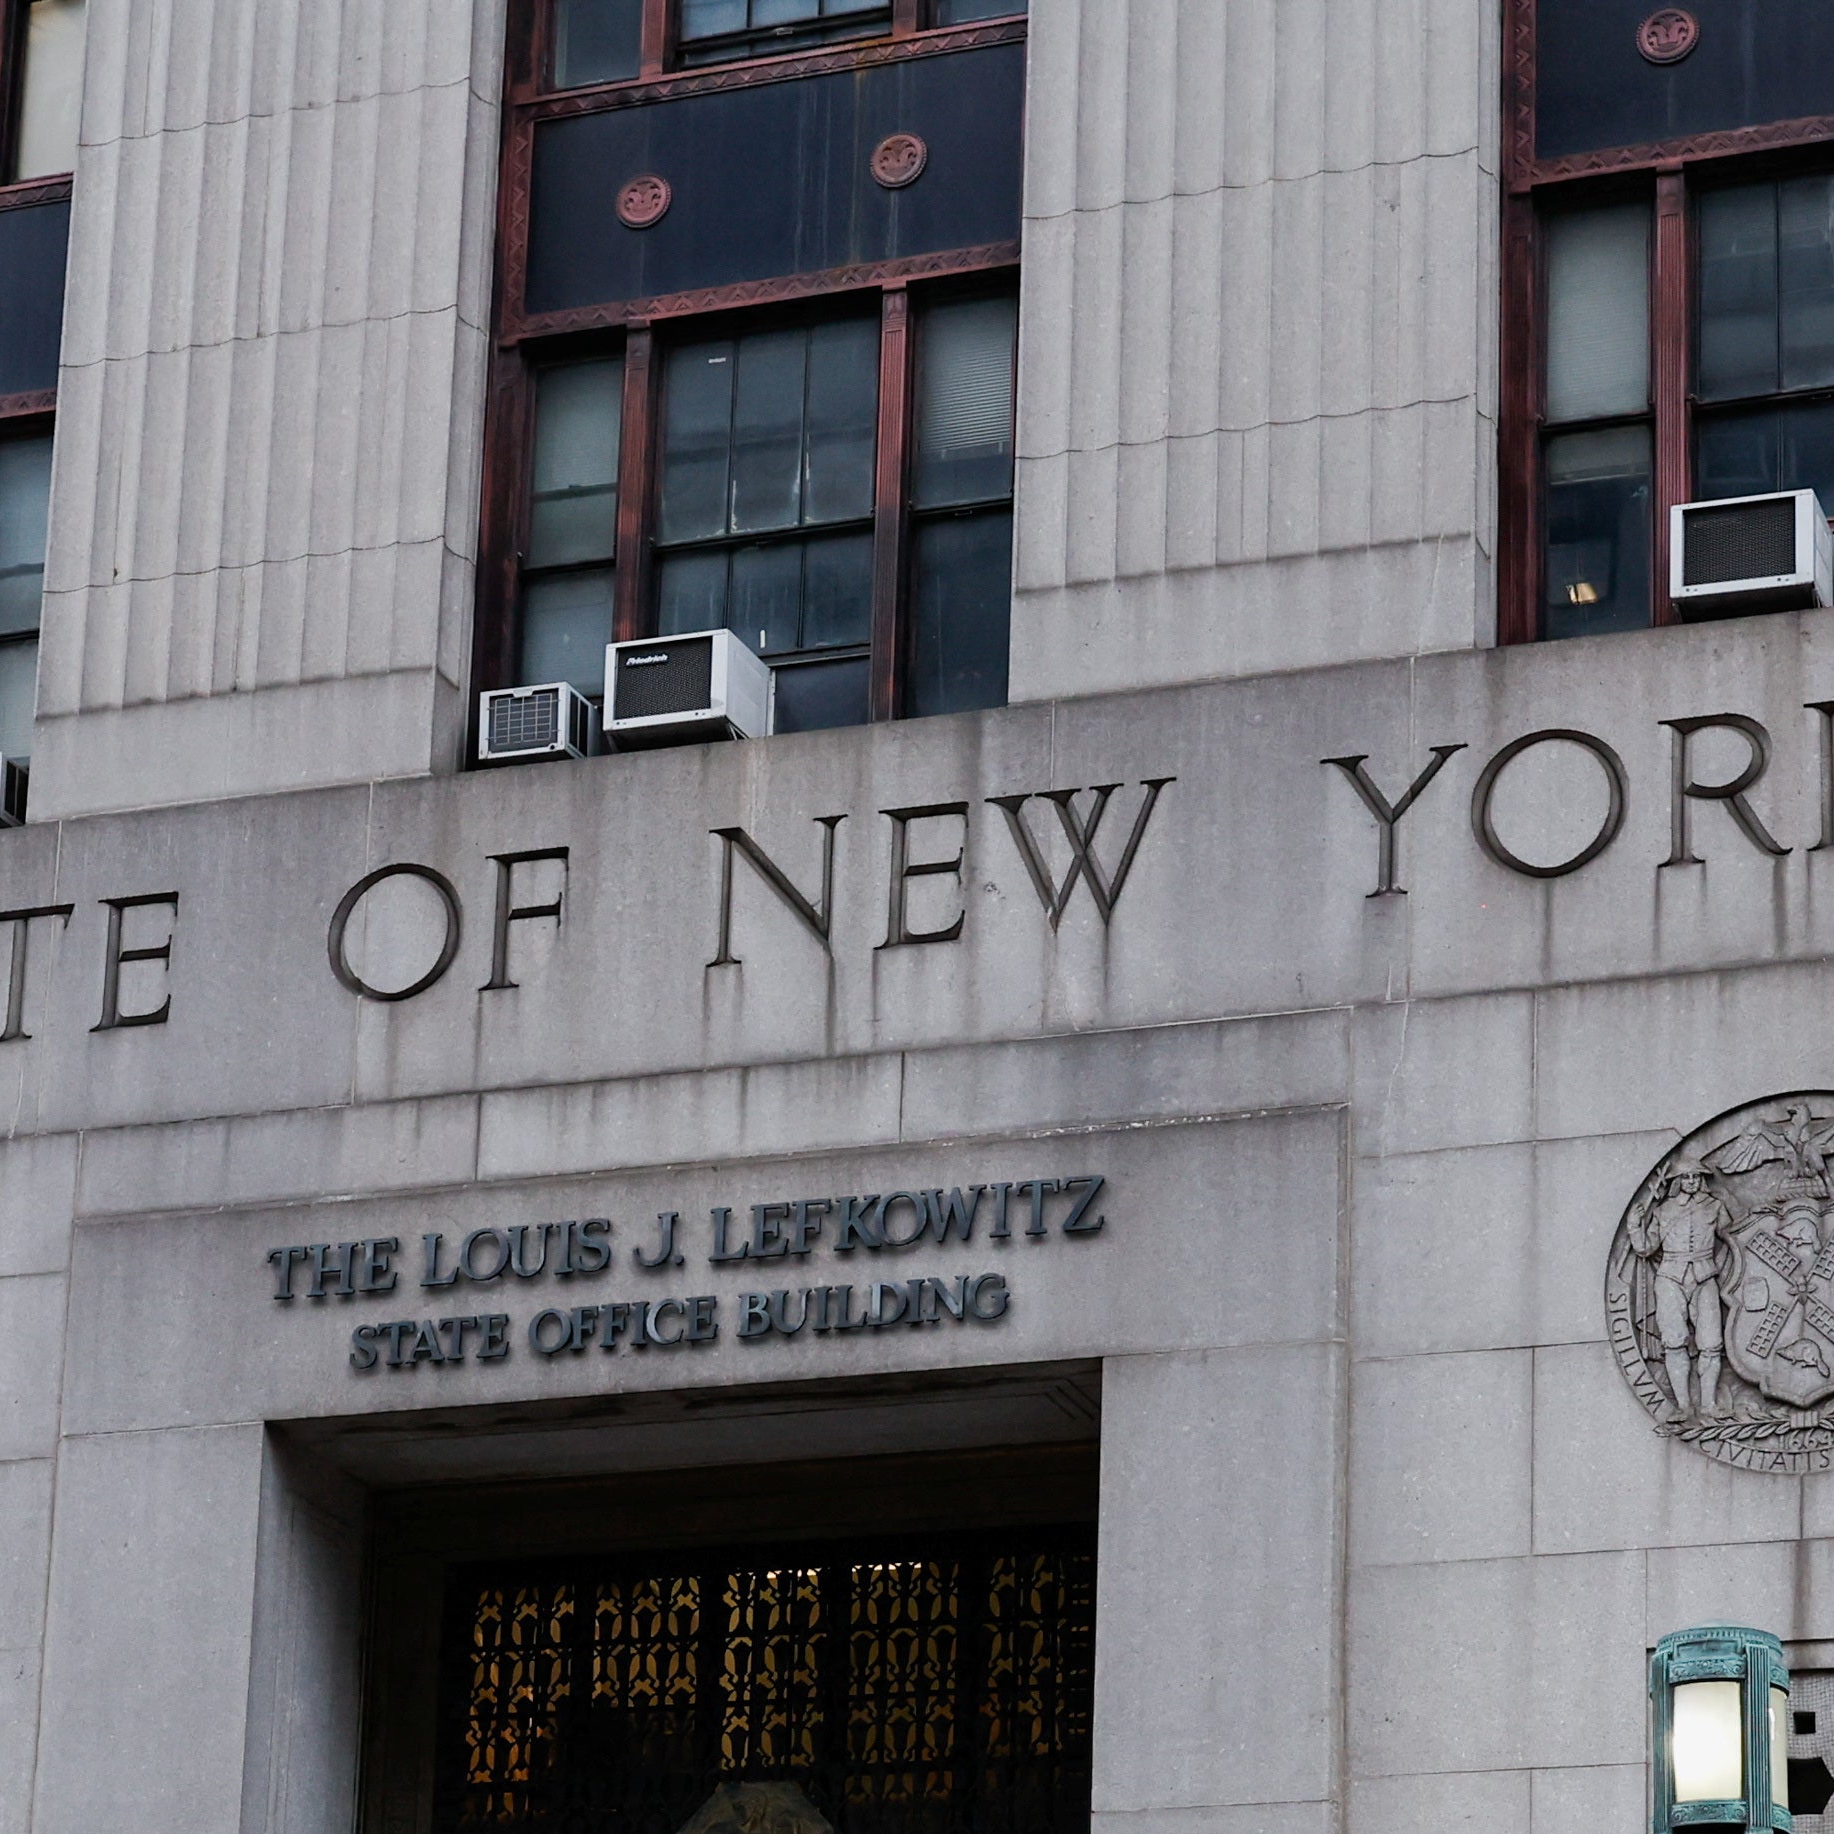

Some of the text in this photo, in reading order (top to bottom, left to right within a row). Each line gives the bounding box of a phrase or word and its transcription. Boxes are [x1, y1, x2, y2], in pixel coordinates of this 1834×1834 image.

[327, 846, 570, 1001] OF
[705, 776, 1177, 968] NEW
[266, 1173, 1106, 1300] THE LOUIS J. LEFKOWITZ
[348, 1271, 1011, 1373] STATE OFFICE BUILDING
[1608, 1292, 1666, 1415] SIGILLVM
[1698, 1439, 1831, 1472] CIVITATIS
